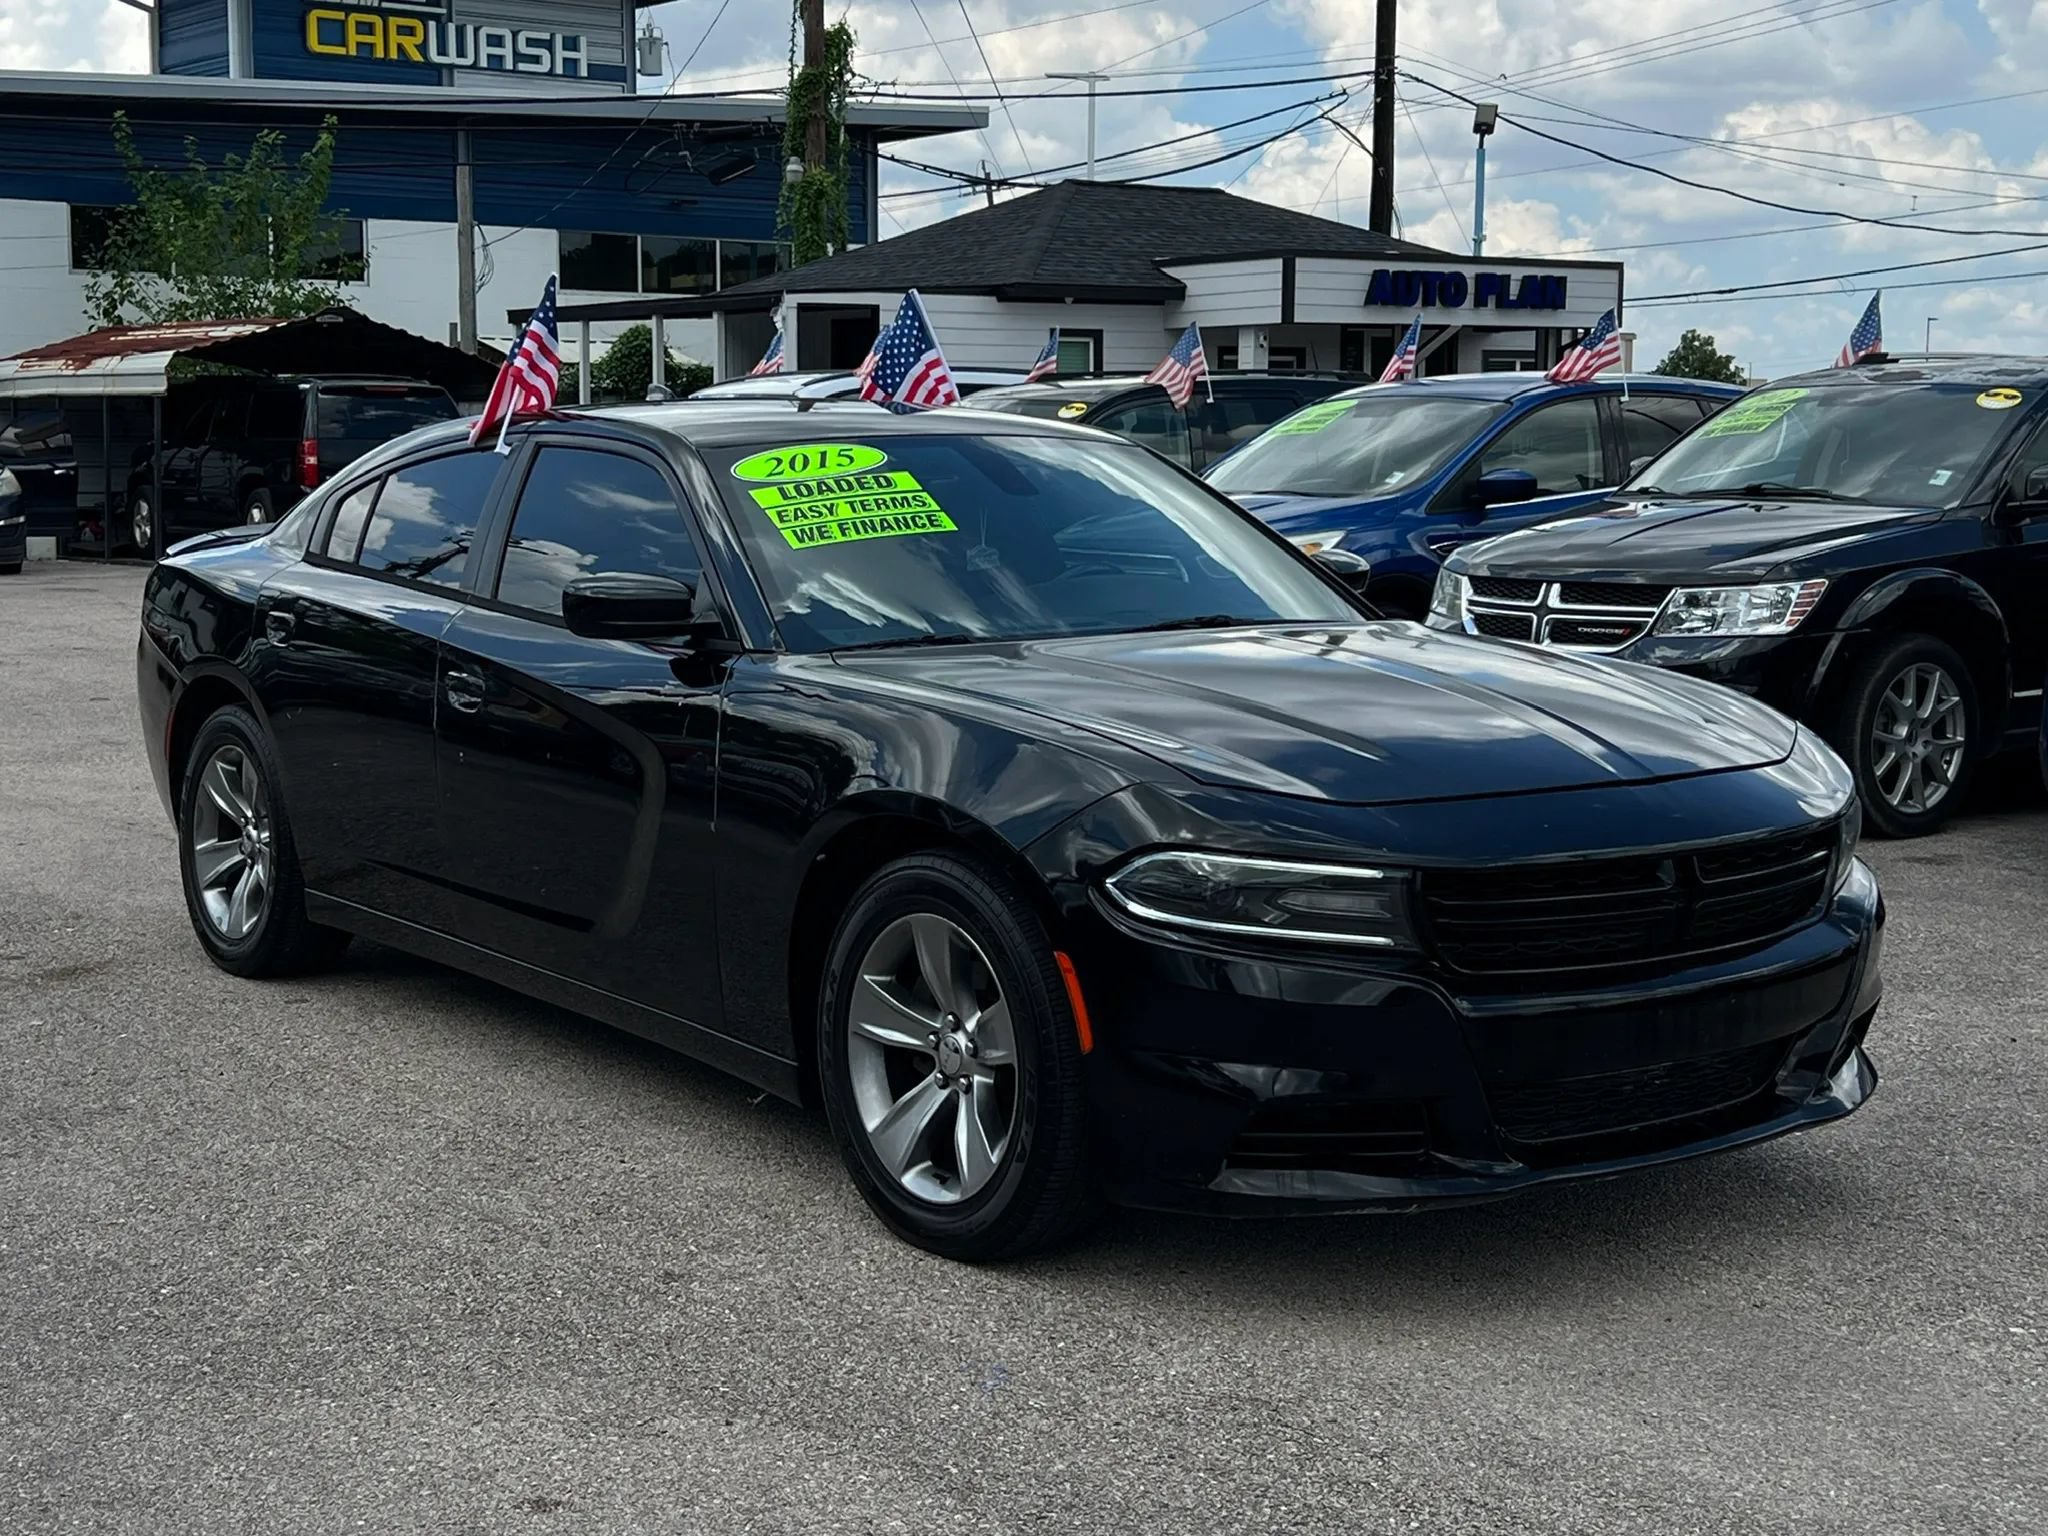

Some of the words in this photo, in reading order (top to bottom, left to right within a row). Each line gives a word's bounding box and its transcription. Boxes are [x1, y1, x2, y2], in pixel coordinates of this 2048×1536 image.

[1364, 269, 1469, 308] AUTO
[1473, 272, 1568, 310] PLAN
[764, 448, 855, 478] 2015
[776, 474, 897, 501] LOADED
[775, 502, 839, 524] EASY
[844, 494, 931, 515] TERMS
[791, 524, 834, 545] WE
[836, 513, 945, 538] FINANCE
